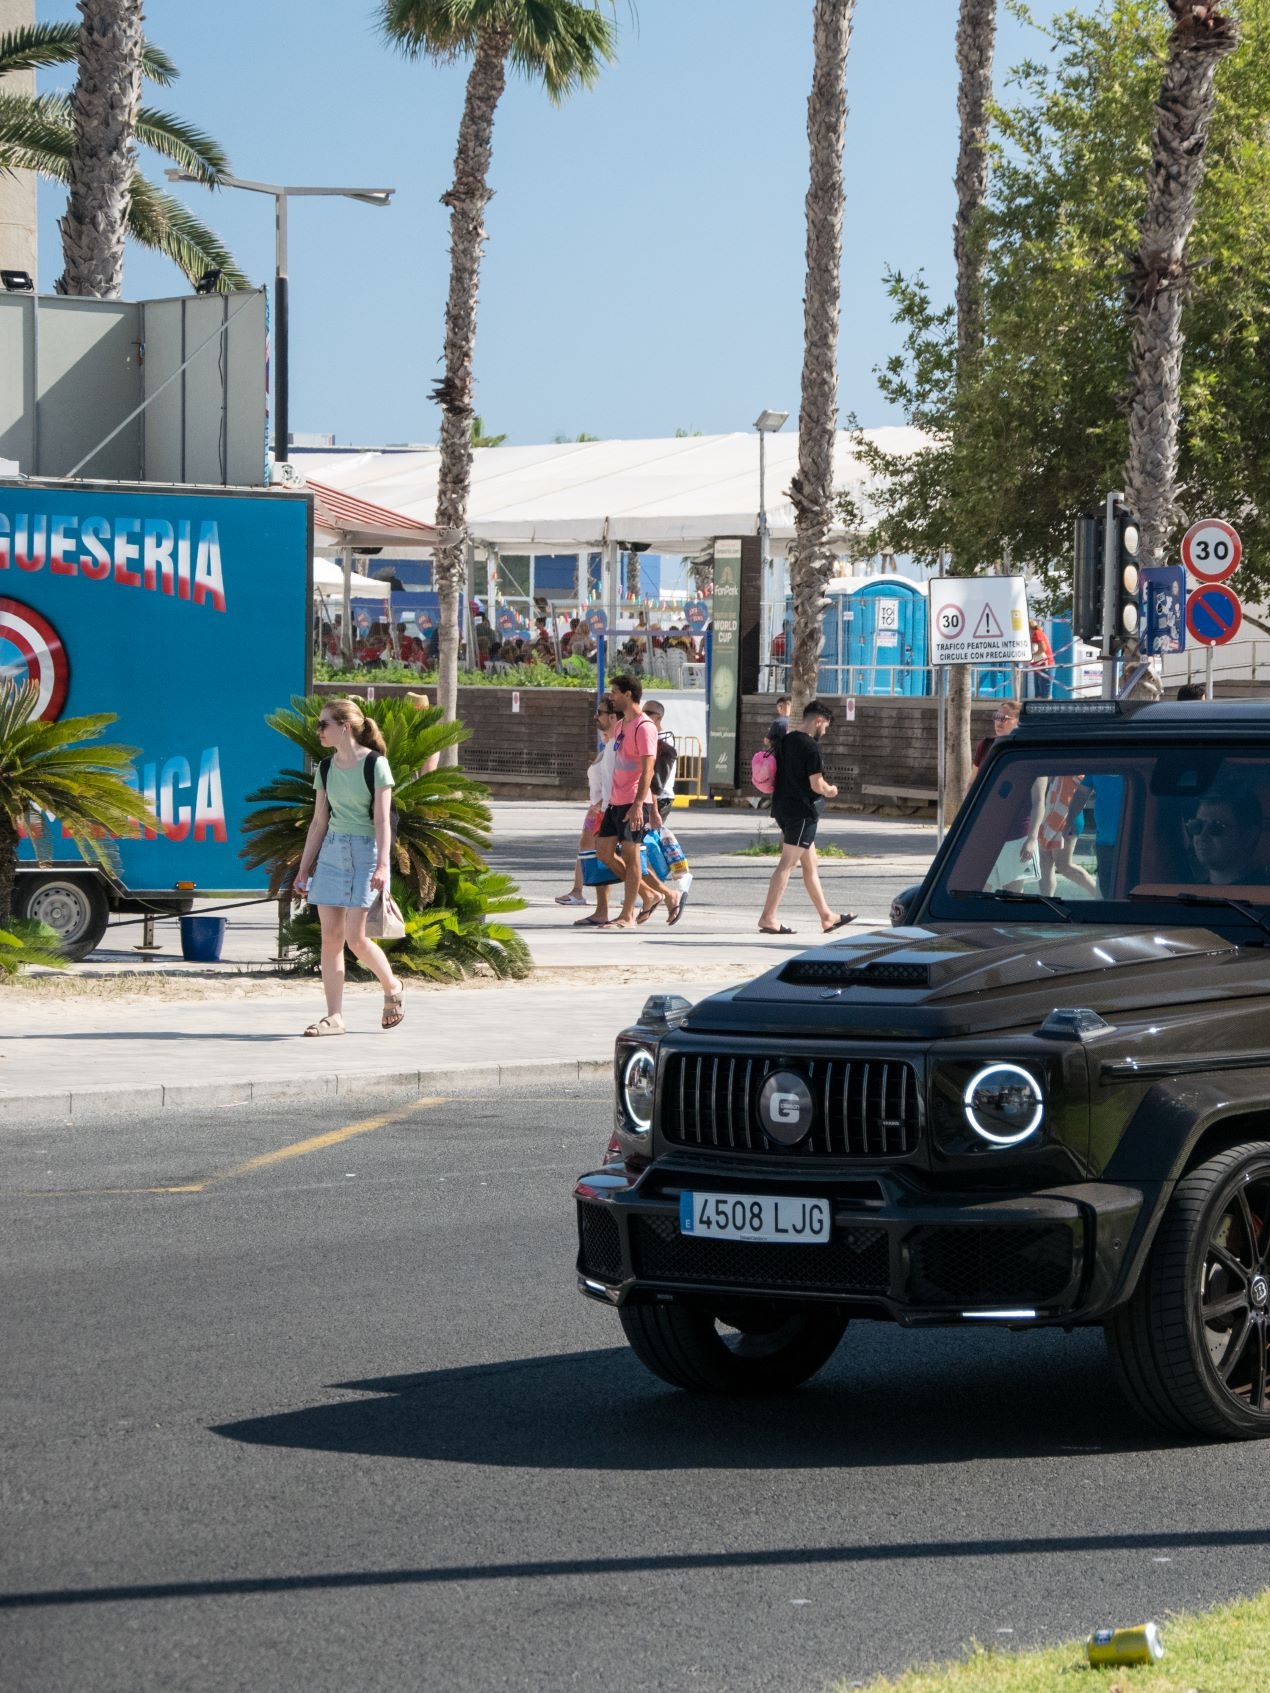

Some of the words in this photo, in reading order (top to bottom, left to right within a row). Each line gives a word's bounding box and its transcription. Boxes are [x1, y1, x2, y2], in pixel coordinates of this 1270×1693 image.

[1196, 540, 1229, 560] 30
[714, 620, 738, 631] WORLD
[942, 614, 959, 628] 30
[718, 632, 733, 643] CUP
[967, 641, 1000, 650] PEATONAL
[940, 652, 968, 661] CIRCULE
[971, 651, 984, 659] CON
[699, 1198, 763, 1232] 4508
[774, 1202, 824, 1235] LJG
[685, 1219, 691, 1228] E
